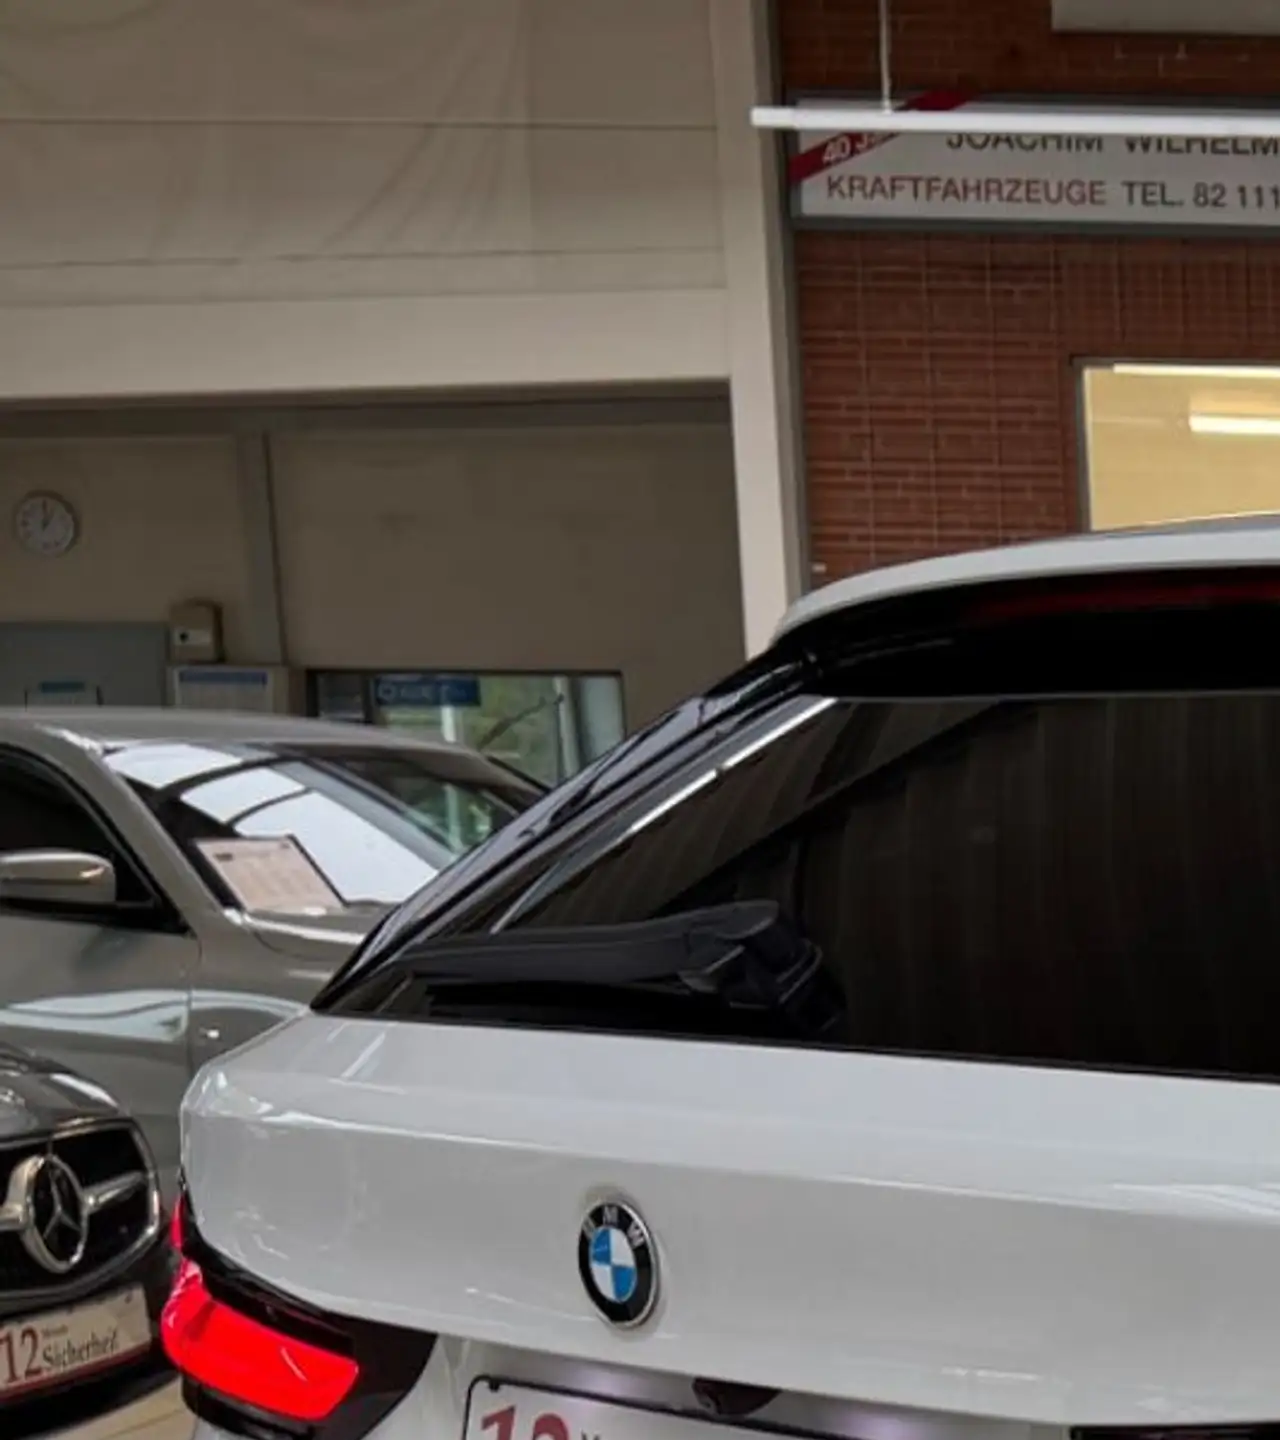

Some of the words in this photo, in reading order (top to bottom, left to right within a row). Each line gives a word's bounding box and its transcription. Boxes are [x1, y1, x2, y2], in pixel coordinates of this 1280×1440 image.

[826, 174, 1107, 207] KRAFTFAHRZEUGE
[1121, 180, 1184, 207] TEL.
[1192, 181, 1228, 209] 82
[0, 1324, 43, 1383] 12
